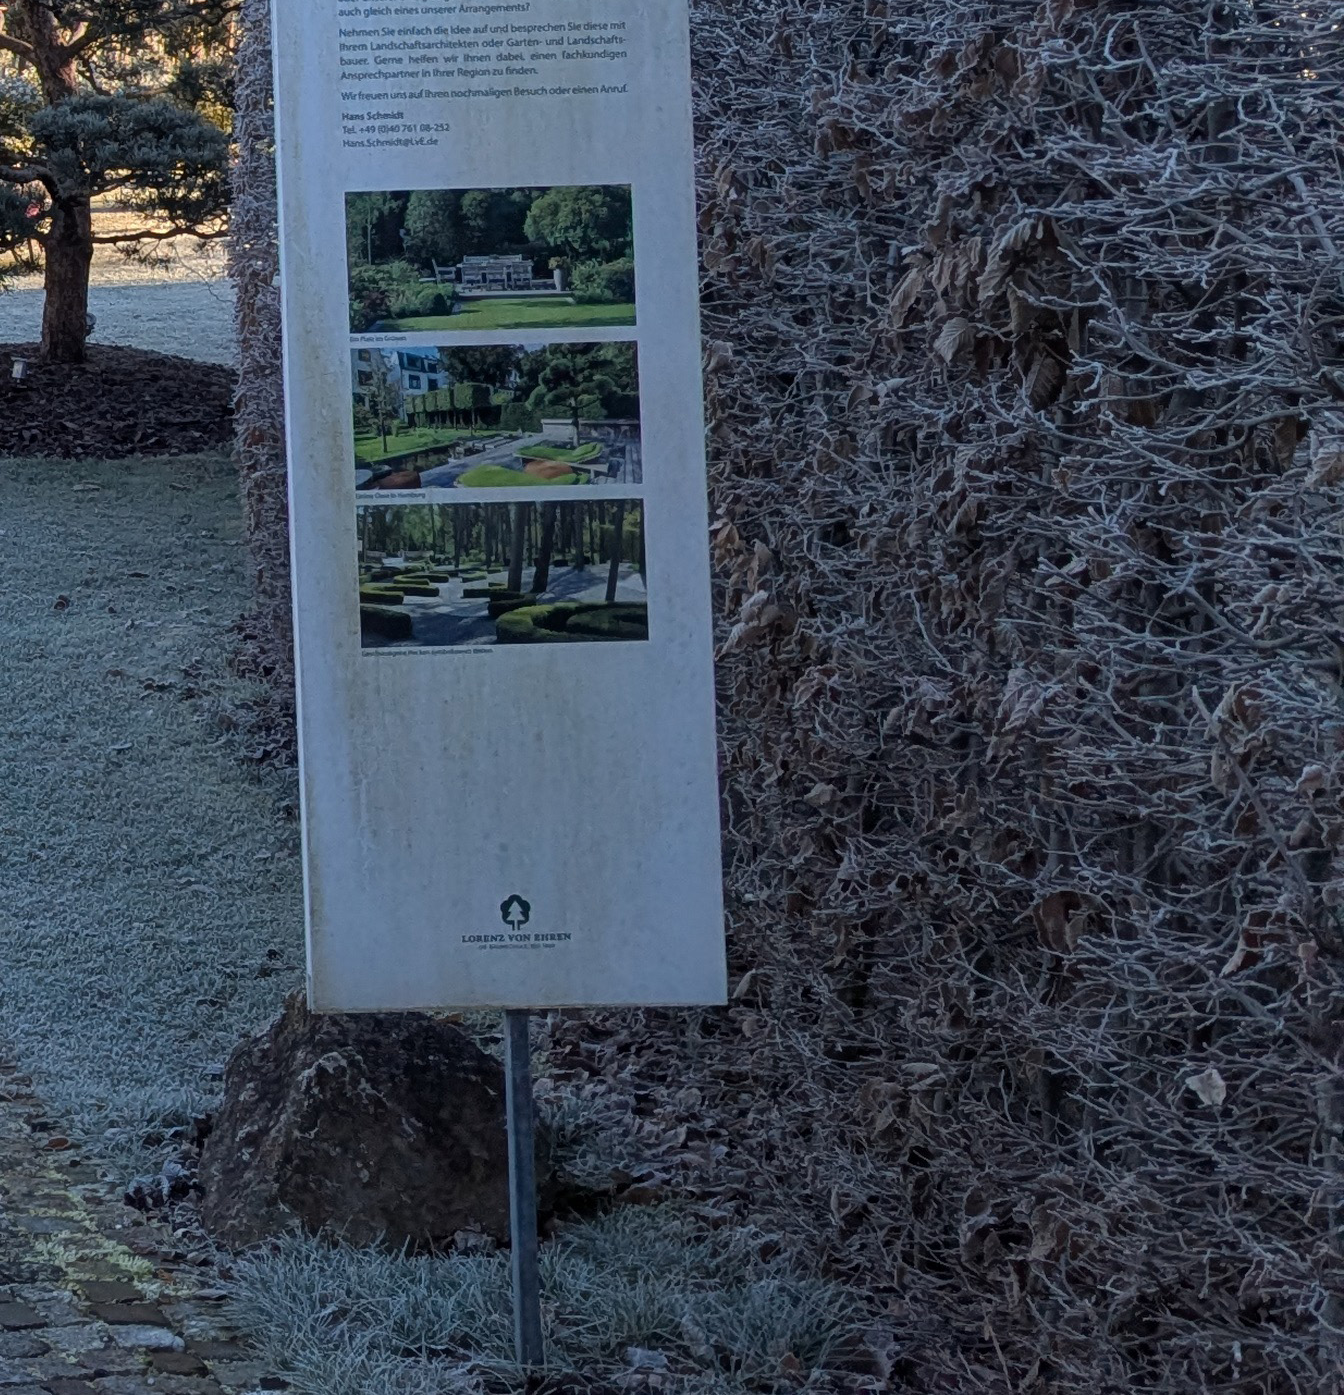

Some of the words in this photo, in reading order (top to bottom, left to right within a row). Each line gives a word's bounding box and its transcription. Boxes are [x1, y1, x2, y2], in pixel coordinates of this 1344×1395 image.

[338, 7, 361, 16] auch
[364, 7, 392, 18] gleich
[394, 7, 419, 15] eines
[459, 3, 530, 14] Arrangements?
[339, 28, 380, 37] Nehmen
[381, 27, 395, 36] Sie
[398, 26, 432, 36] einfach
[434, 26, 448, 34] die
[450, 25, 471, 34] Idee
[473, 24, 488, 34] auf
[490, 24, 508, 33] und
[511, 23, 566, 34] besprechen
[568, 22, 581, 31] Sie
[583, 22, 608, 30] diese
[610, 21, 626, 30] mit
[339, 43, 367, 51] Ihrem
[370, 40, 479, 50] Landschaftsarchitekten
[482, 39, 504, 48] oder
[506, 37, 542, 47] Garten-
[546, 36, 564, 45] und
[567, 35, 626, 45] Landschafts-
[340, 70, 419, 80] Ansprechpartner
[422, 69, 431, 78] in
[433, 68, 455, 77] Ihrer
[457, 68, 490, 78] Region
[492, 68, 503, 76] zu
[506, 66, 538, 75] finden.
[508, 934, 531, 942] VON
